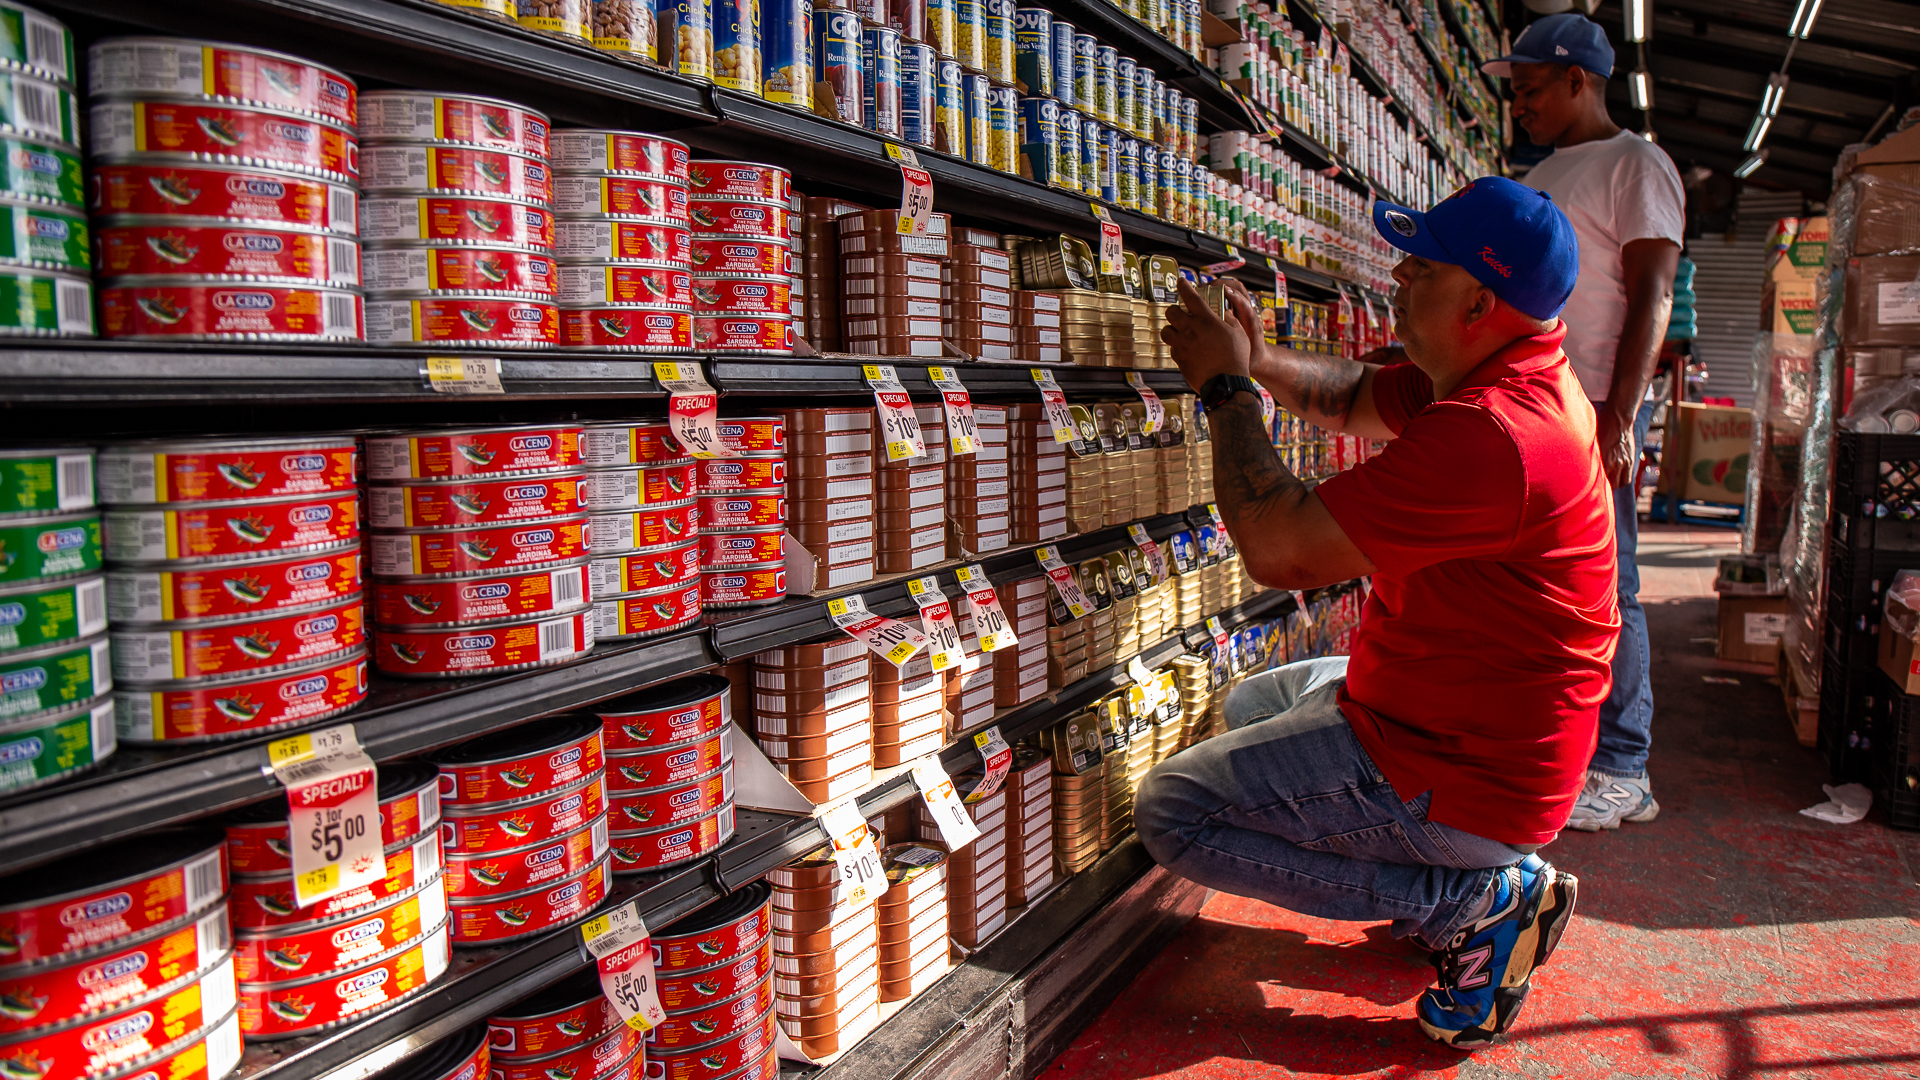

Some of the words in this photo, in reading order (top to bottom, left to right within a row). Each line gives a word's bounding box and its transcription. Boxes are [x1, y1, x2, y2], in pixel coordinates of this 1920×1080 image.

[678, 3, 700, 16] Chick
[537, 19, 562, 28] PRIME
[1016, 14, 1049, 30] OYA
[731, 24, 753, 36] Chick
[990, 90, 1017, 108] OYA
[1119, 139, 1139, 153] OYA
[906, 169, 928, 182] SPECIAL!
[1478, 246, 1512, 278] Knicks
[467, 364, 487, 374] $1.79
[681, 367, 695, 375] $1.79
[676, 398, 710, 410] SPECIAL!
[883, 394, 906, 403] SPECIAL!
[947, 394, 966, 402] SPECIAL!
[891, 409, 896, 417] 3
[682, 418, 686, 428] 3
[688, 417, 697, 429] for
[514, 455, 550, 464] SARDINAS
[509, 504, 544, 514] SARDINAS
[516, 549, 552, 559] SARDINAS
[973, 591, 993, 602] SPECIAL!
[466, 604, 507, 614] SARDINES
[926, 606, 948, 617] SPECIAL!
[981, 606, 985, 614] 3
[934, 622, 938, 630] 3
[449, 655, 491, 665] SARDINES
[318, 733, 342, 748] $1.79
[989, 752, 1008, 768] SPECIAL!
[302, 774, 364, 805] SPECIAL!
[314, 811, 322, 826] 3
[326, 809, 342, 822] for
[588, 922, 602, 933] $1.91
[612, 910, 628, 922] $1.79
[606, 942, 644, 971] SPECIAL!
[614, 976, 620, 988] 3
[621, 972, 632, 985] for
